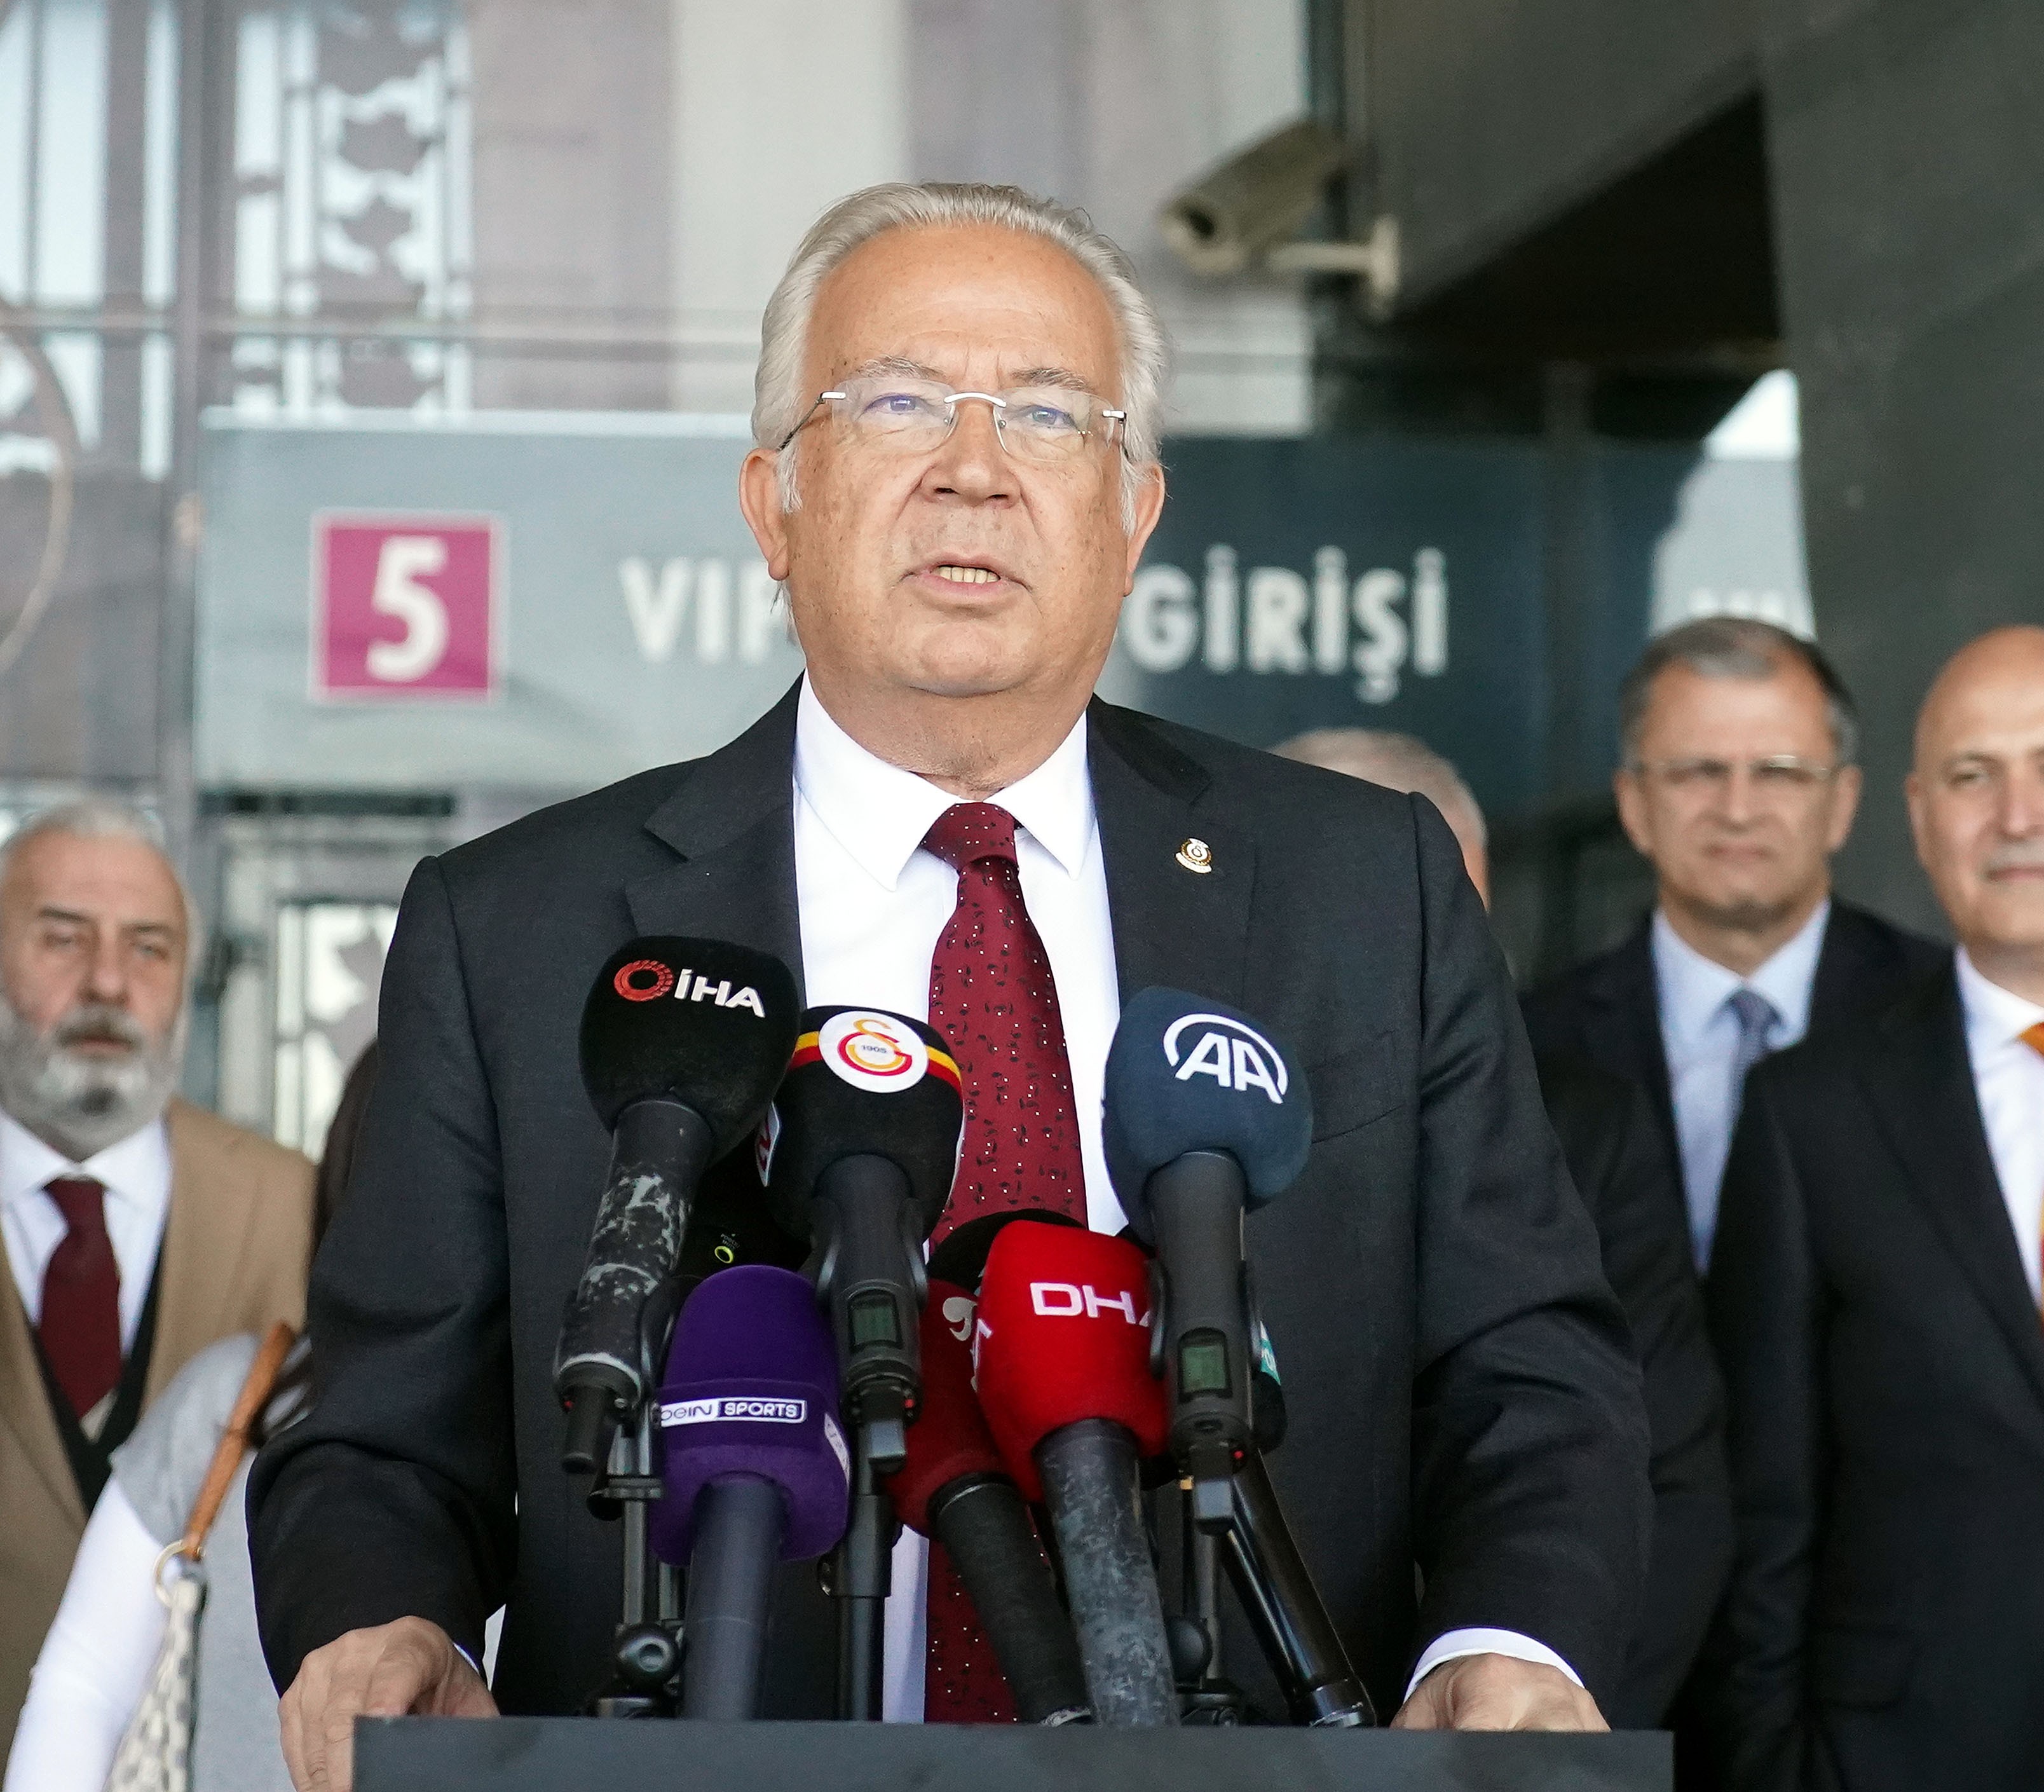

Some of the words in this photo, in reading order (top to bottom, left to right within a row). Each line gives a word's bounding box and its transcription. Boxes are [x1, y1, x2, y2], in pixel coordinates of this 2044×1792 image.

[367, 535, 450, 681] 5
[1125, 544, 1448, 704] GİRİŞİ
[674, 968, 765, 1018] İHA
[861, 1044, 887, 1053] 1905
[1175, 1032, 1284, 1104] AA
[1030, 1282, 1149, 1327] DH
[724, 1401, 800, 1418] SPORTS
